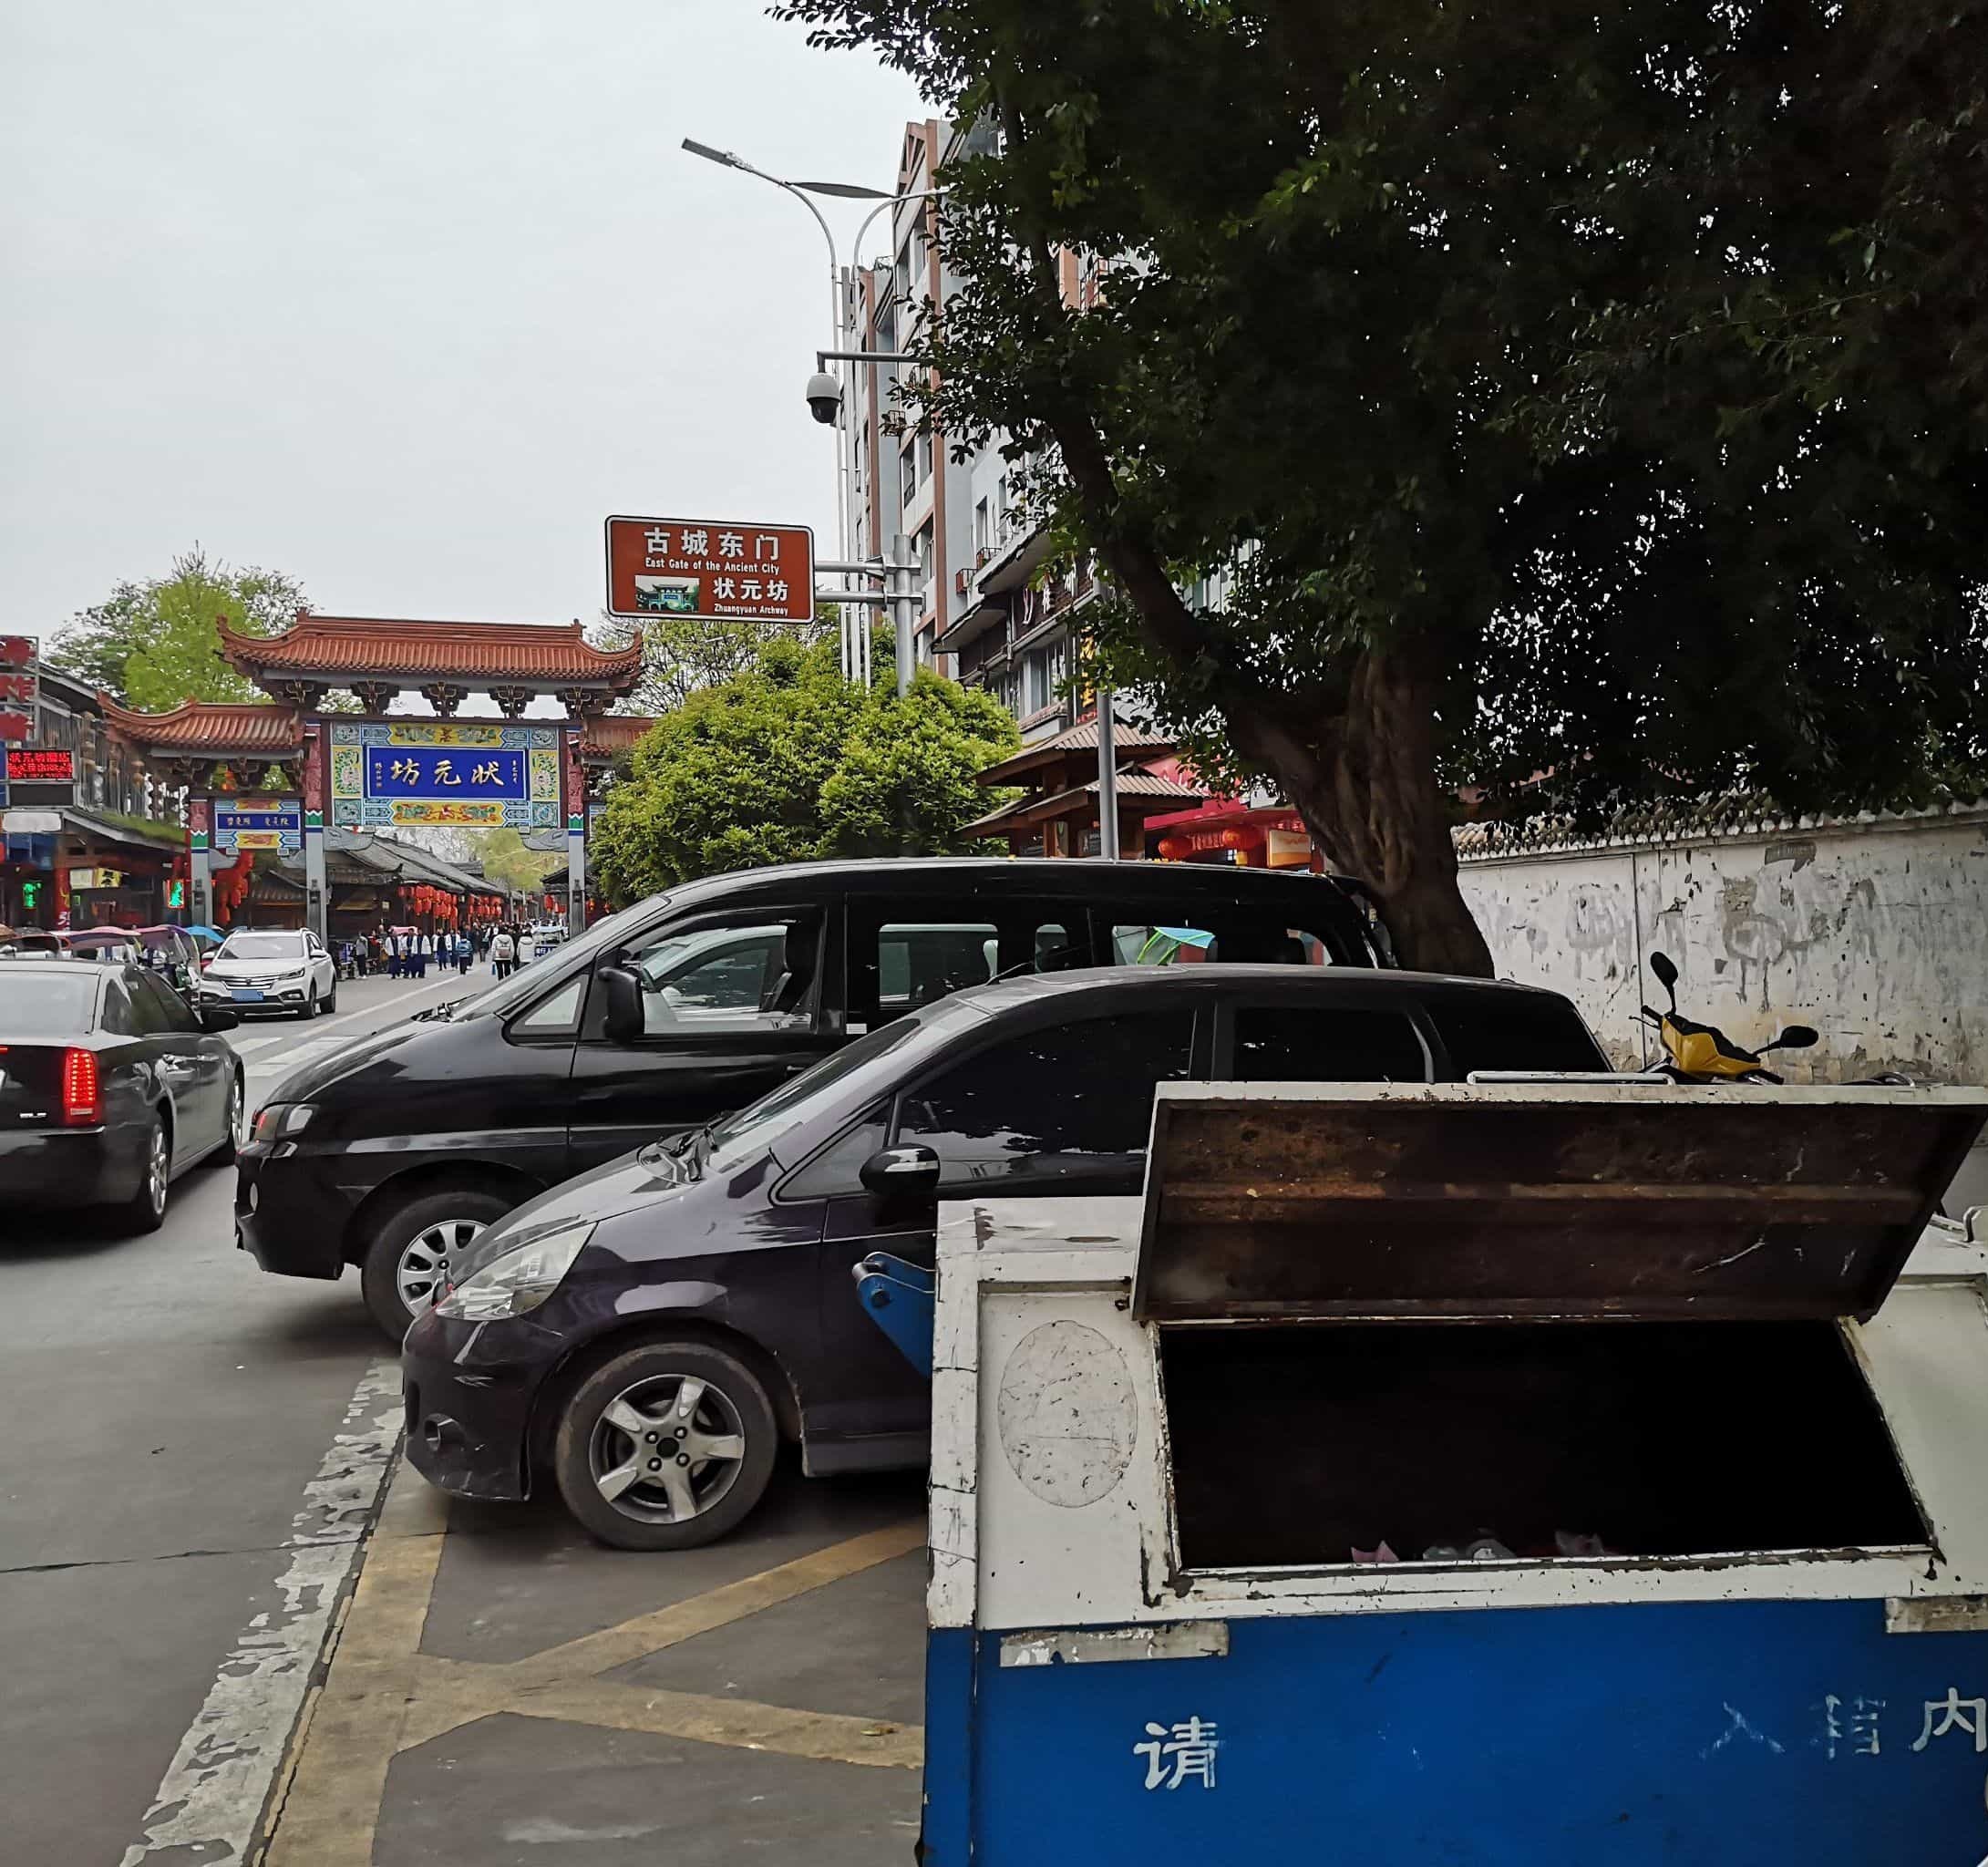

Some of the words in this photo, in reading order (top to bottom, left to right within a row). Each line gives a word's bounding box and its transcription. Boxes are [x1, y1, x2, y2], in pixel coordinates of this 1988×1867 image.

[644, 527, 778, 560] 古城东门
[645, 557, 665, 569] East
[669, 558, 689, 570] Gate
[693, 560, 702, 570] of
[706, 561, 721, 572] the
[724, 562, 758, 573] Ancient
[762, 563, 780, 575] City
[713, 576, 788, 602] 状元坊
[714, 603, 757, 615] Zhuangyuan
[759, 605, 788, 616] Archway
[1133, 1716, 1218, 1790] 请
